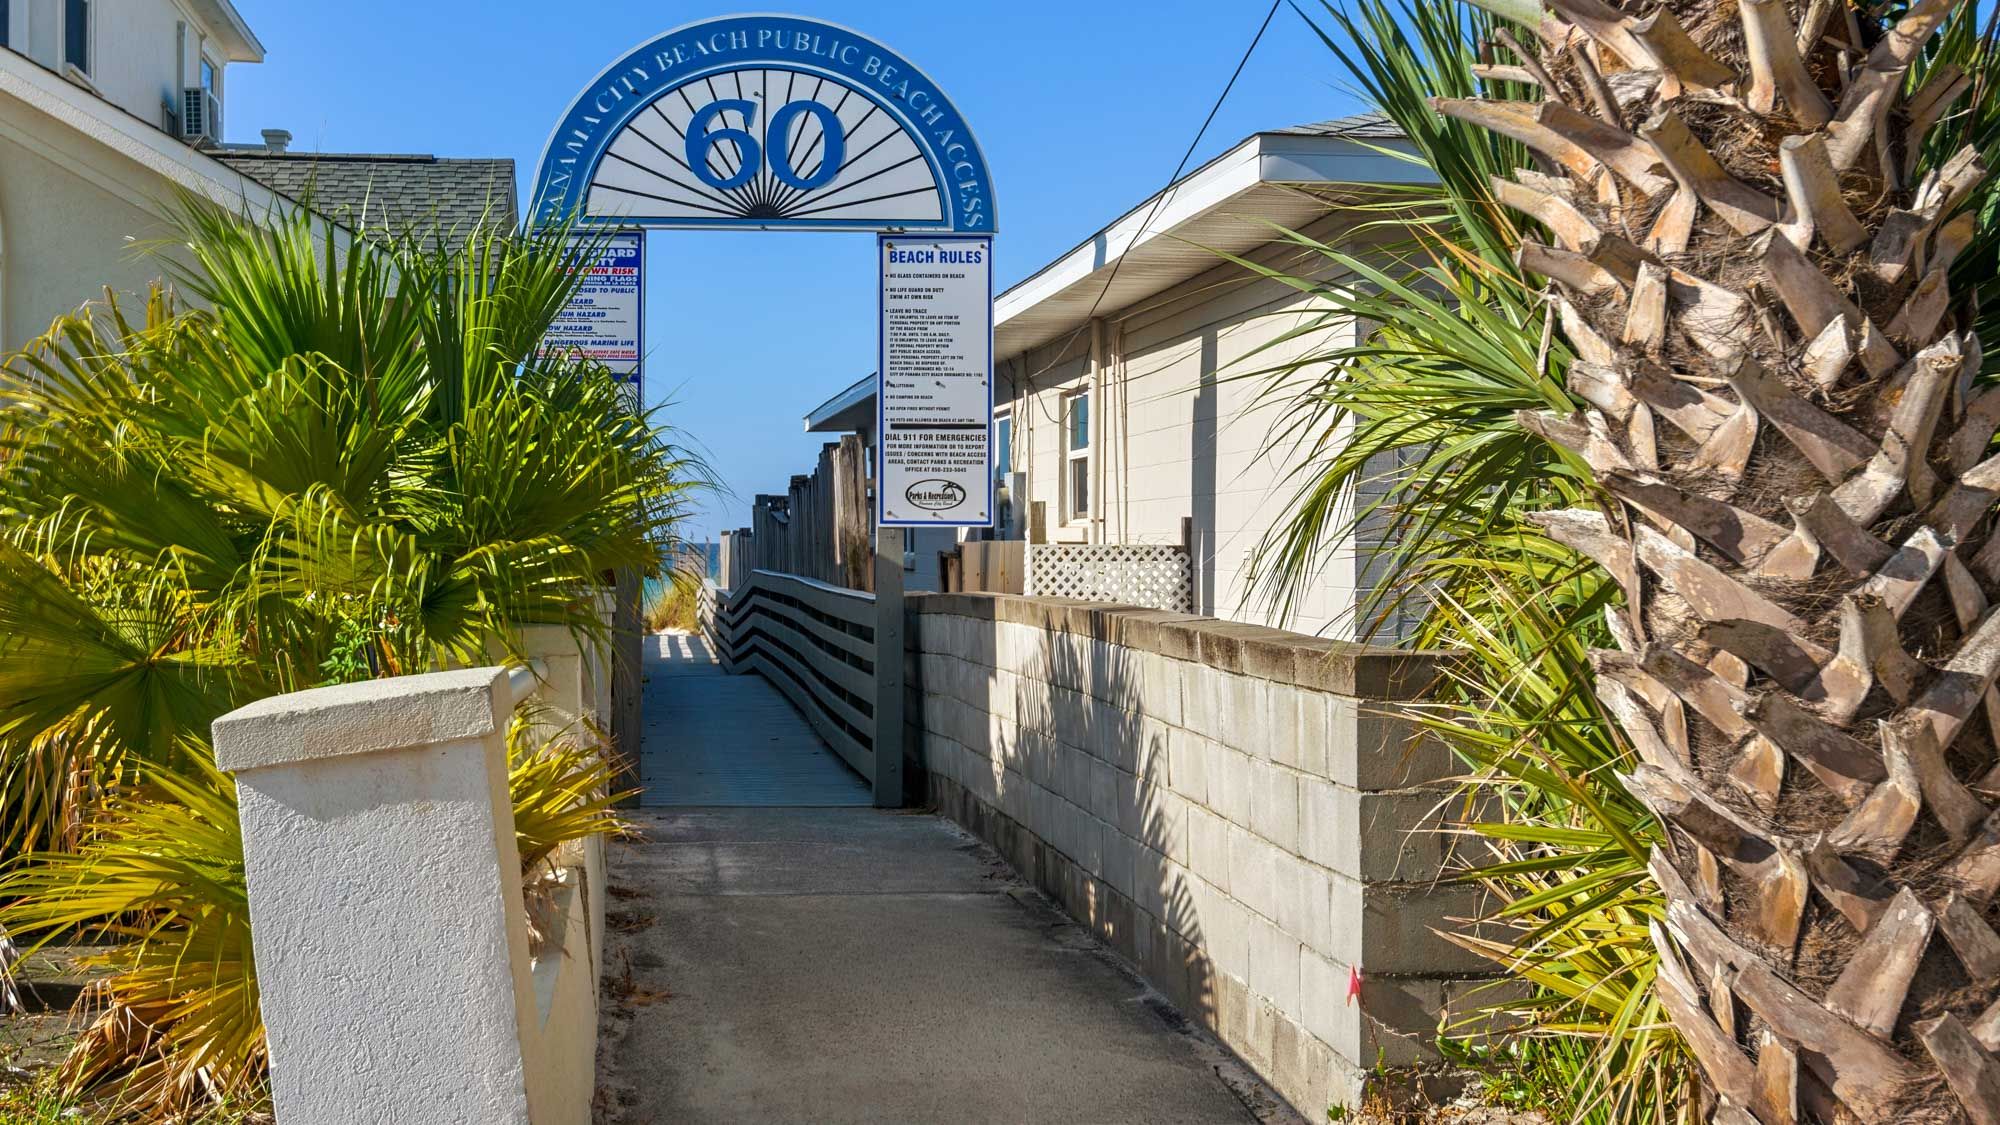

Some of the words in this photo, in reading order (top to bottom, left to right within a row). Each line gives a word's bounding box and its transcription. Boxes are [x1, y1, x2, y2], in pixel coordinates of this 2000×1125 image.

[596, 64, 650, 112] CITY
[656, 30, 748, 72] BEACH
[758, 30, 860, 65] PUBLIC
[862, 56, 945, 127] BEACH
[934, 128, 984, 229] ACCESS
[685, 99, 847, 190] 60
[890, 251, 934, 264] BEACH
[940, 251, 981, 264] RULES
[910, 491, 922, 500] Parks
[928, 491, 953, 500] Recreation
